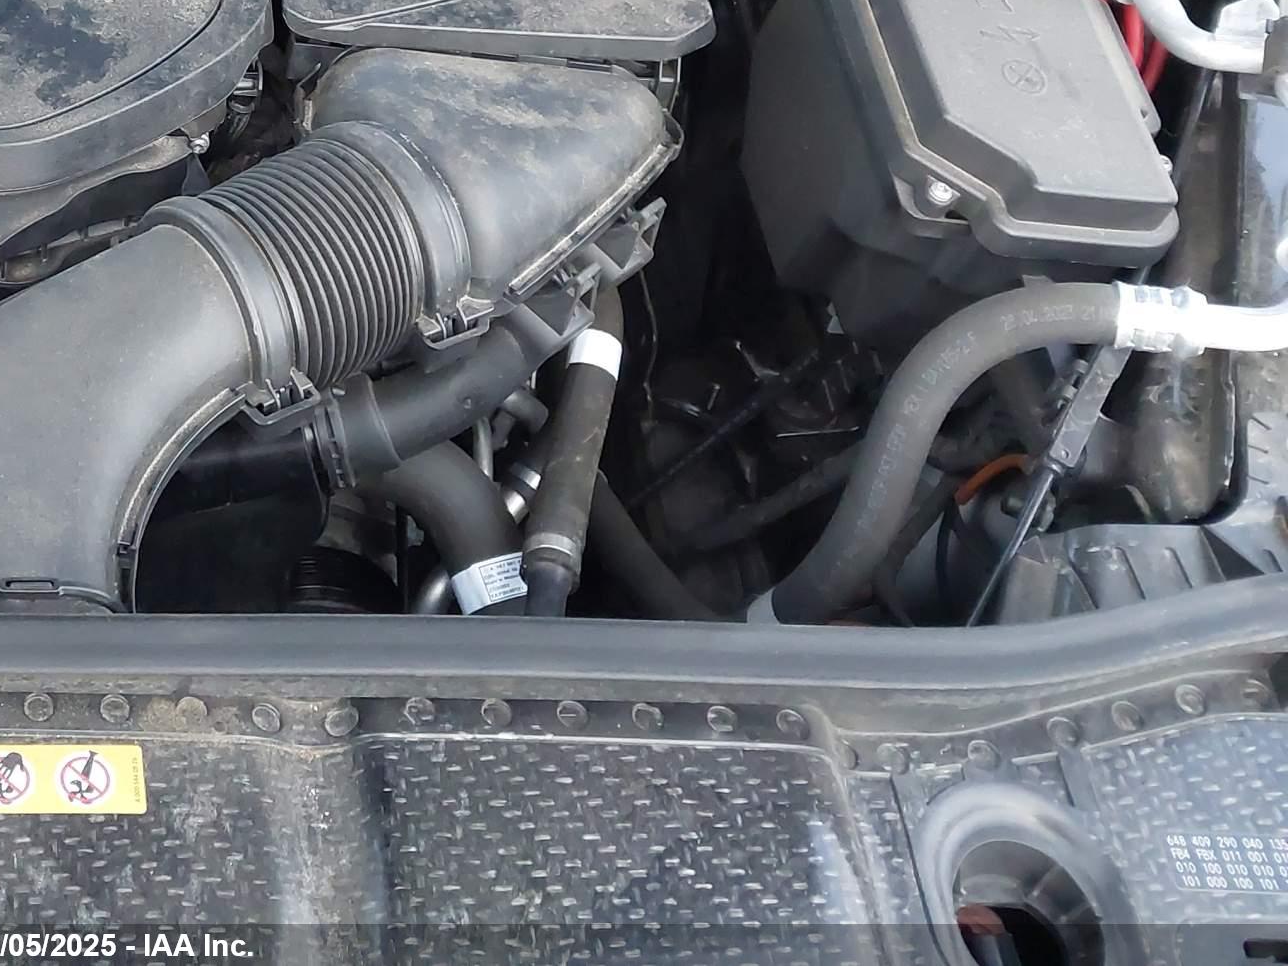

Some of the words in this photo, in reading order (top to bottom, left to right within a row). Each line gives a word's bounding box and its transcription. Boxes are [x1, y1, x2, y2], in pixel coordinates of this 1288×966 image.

[1166, 835, 1187, 847] 648
[1216, 836, 1238, 849] 290
[1222, 849, 1243, 862] 011
[1247, 850, 1269, 863] 001
[1175, 861, 1197, 874] 010
[1203, 862, 1223, 875] 100
[1226, 863, 1249, 876] 010
[1252, 864, 1275, 877] 010
[1182, 875, 1201, 887] 101
[1206, 876, 1228, 889] 000
[1233, 877, 1254, 890] 100
[1259, 878, 1280, 891] 101
